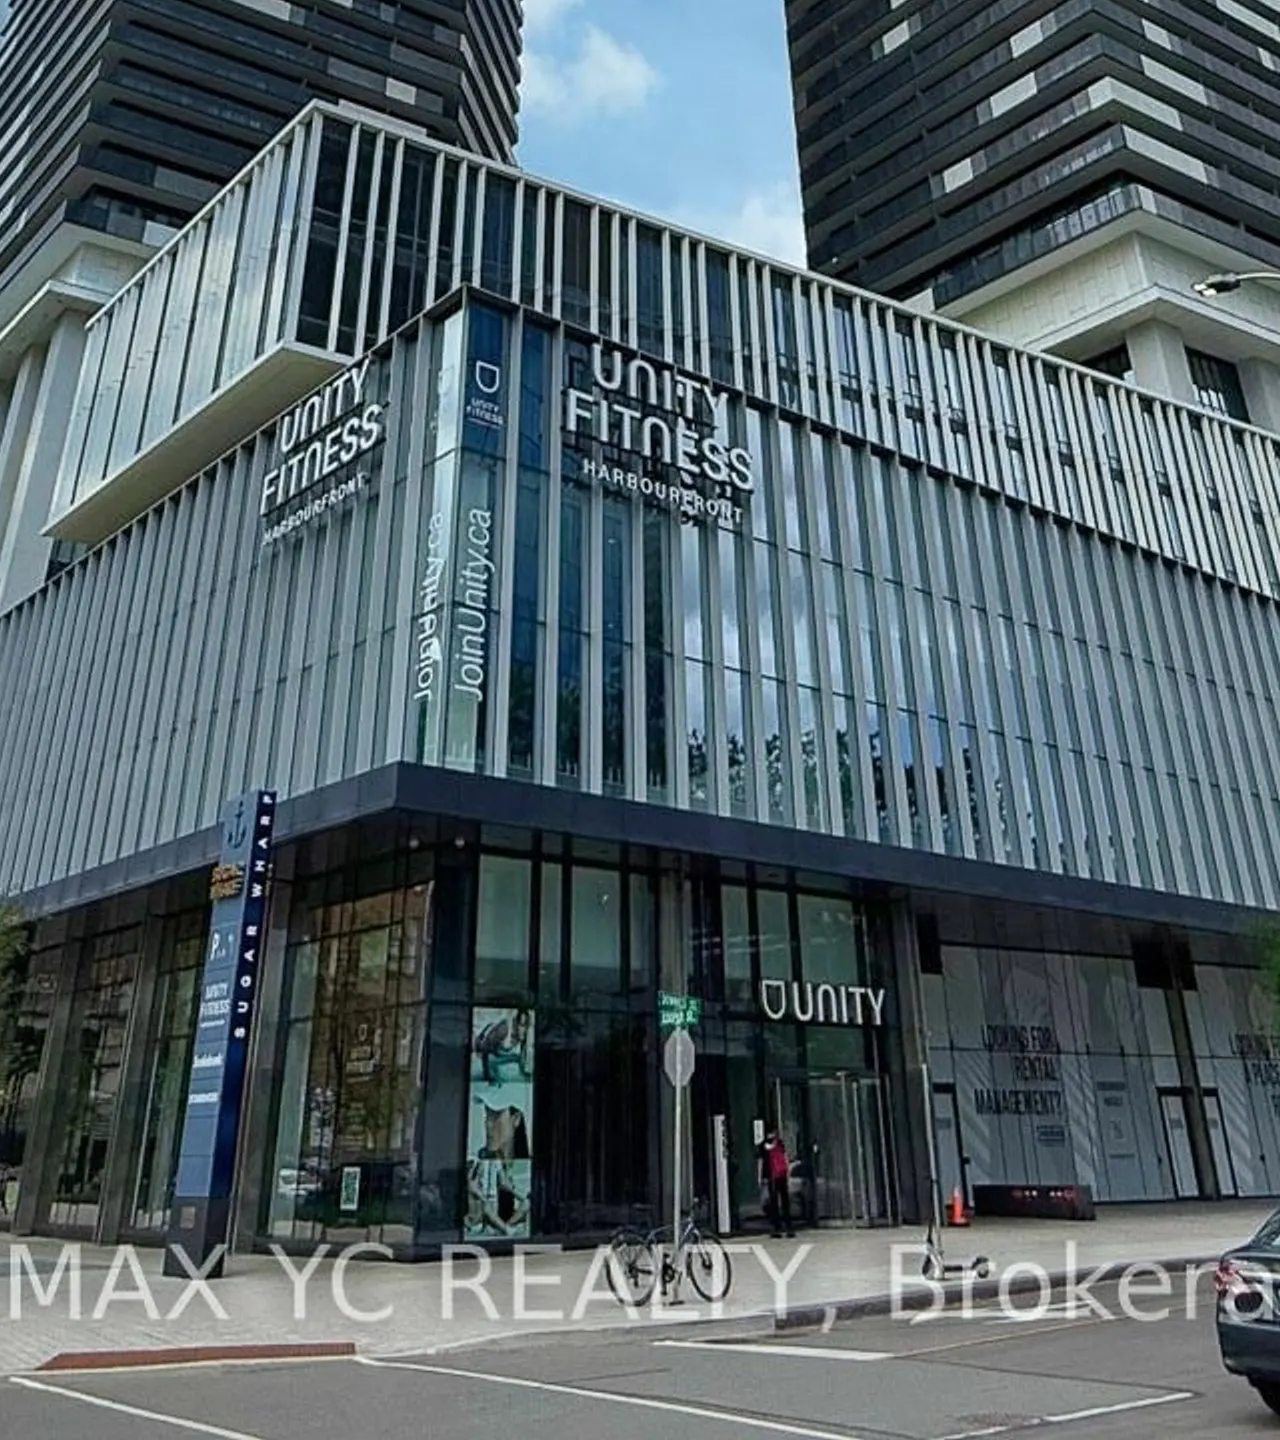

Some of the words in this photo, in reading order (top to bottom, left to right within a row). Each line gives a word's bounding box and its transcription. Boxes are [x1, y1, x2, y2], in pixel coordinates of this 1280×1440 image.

[281, 358, 370, 452] UNITY
[592, 343, 728, 431] UNITY
[260, 404, 384, 515] FITNESS
[566, 388, 754, 490] FITNESS
[582, 458, 744, 524] HARBOURFRONT
[454, 508, 495, 702] JoinUnity.ca
[234, 926, 258, 1038] SUGAR
[792, 981, 885, 1025] UNITY
